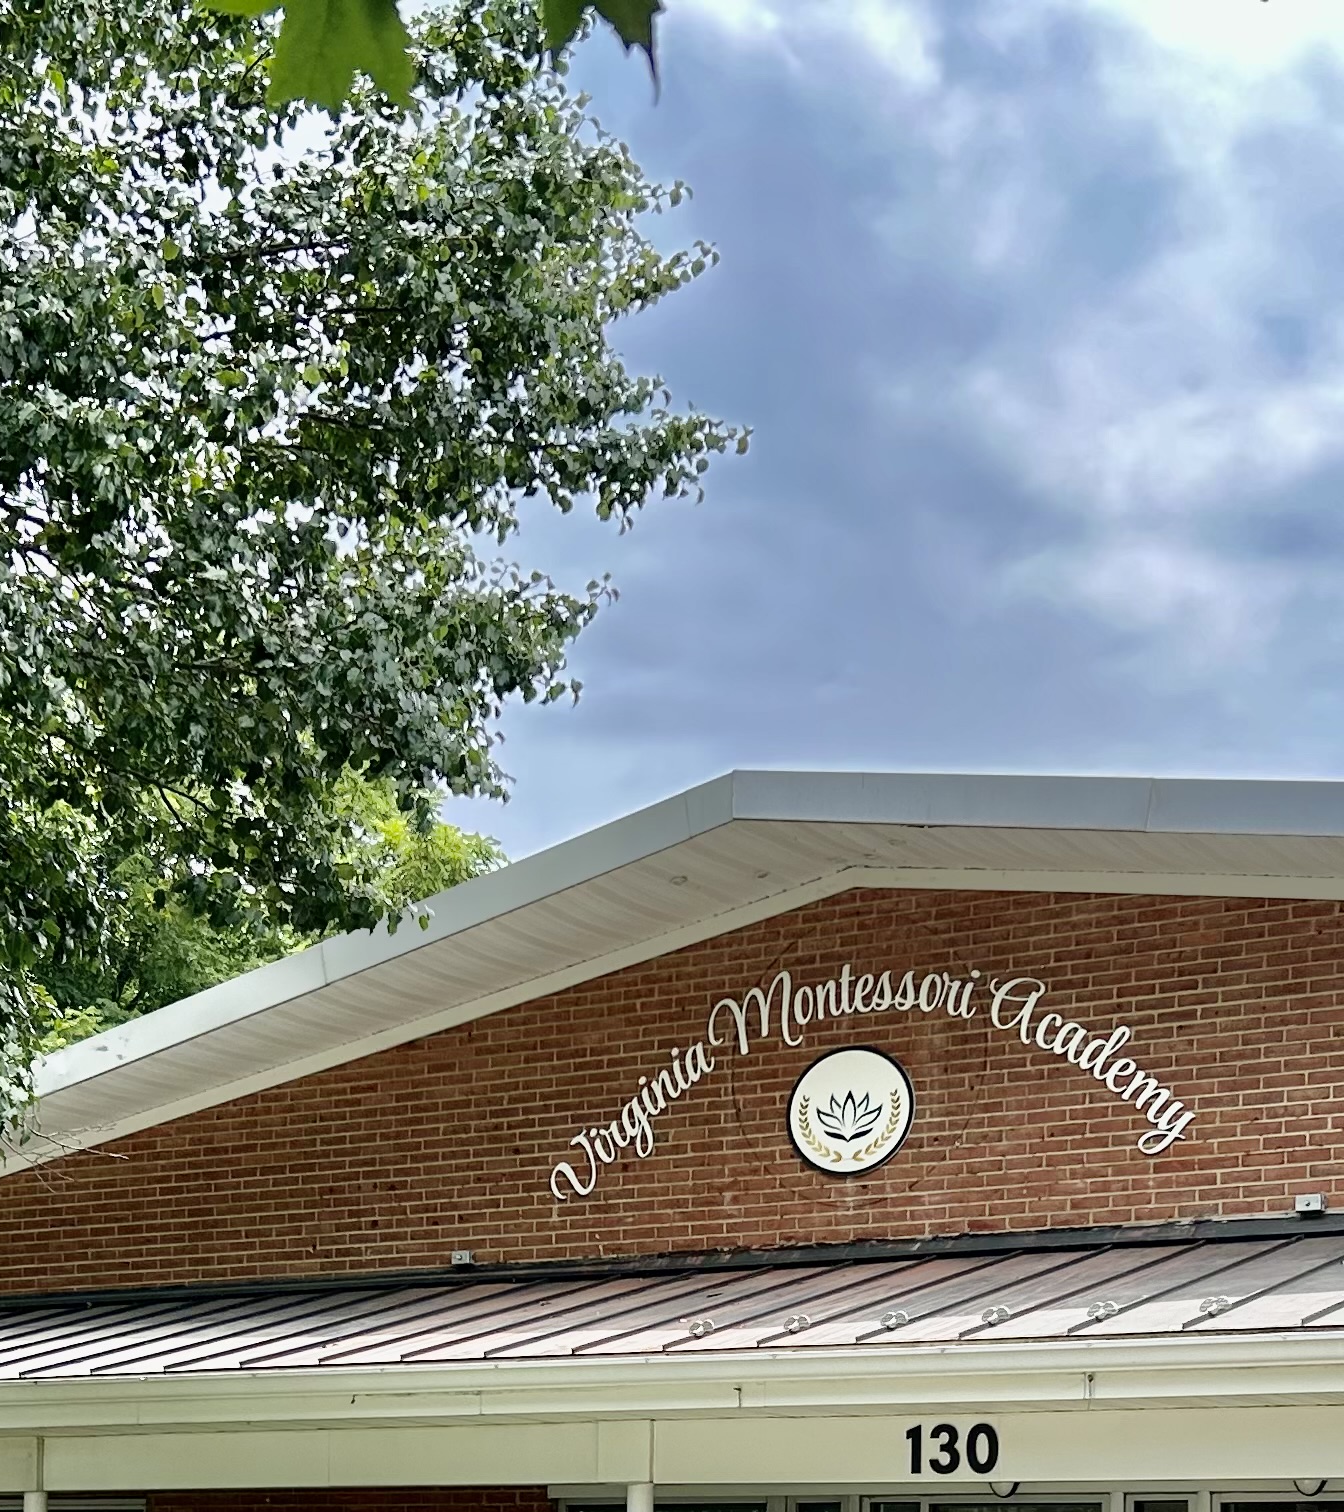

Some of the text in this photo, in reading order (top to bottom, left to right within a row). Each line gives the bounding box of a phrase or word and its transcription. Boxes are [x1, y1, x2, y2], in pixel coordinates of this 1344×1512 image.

[549, 963, 1197, 1201] Virginia Montessori Academy
[905, 1422, 1000, 1476] 130
